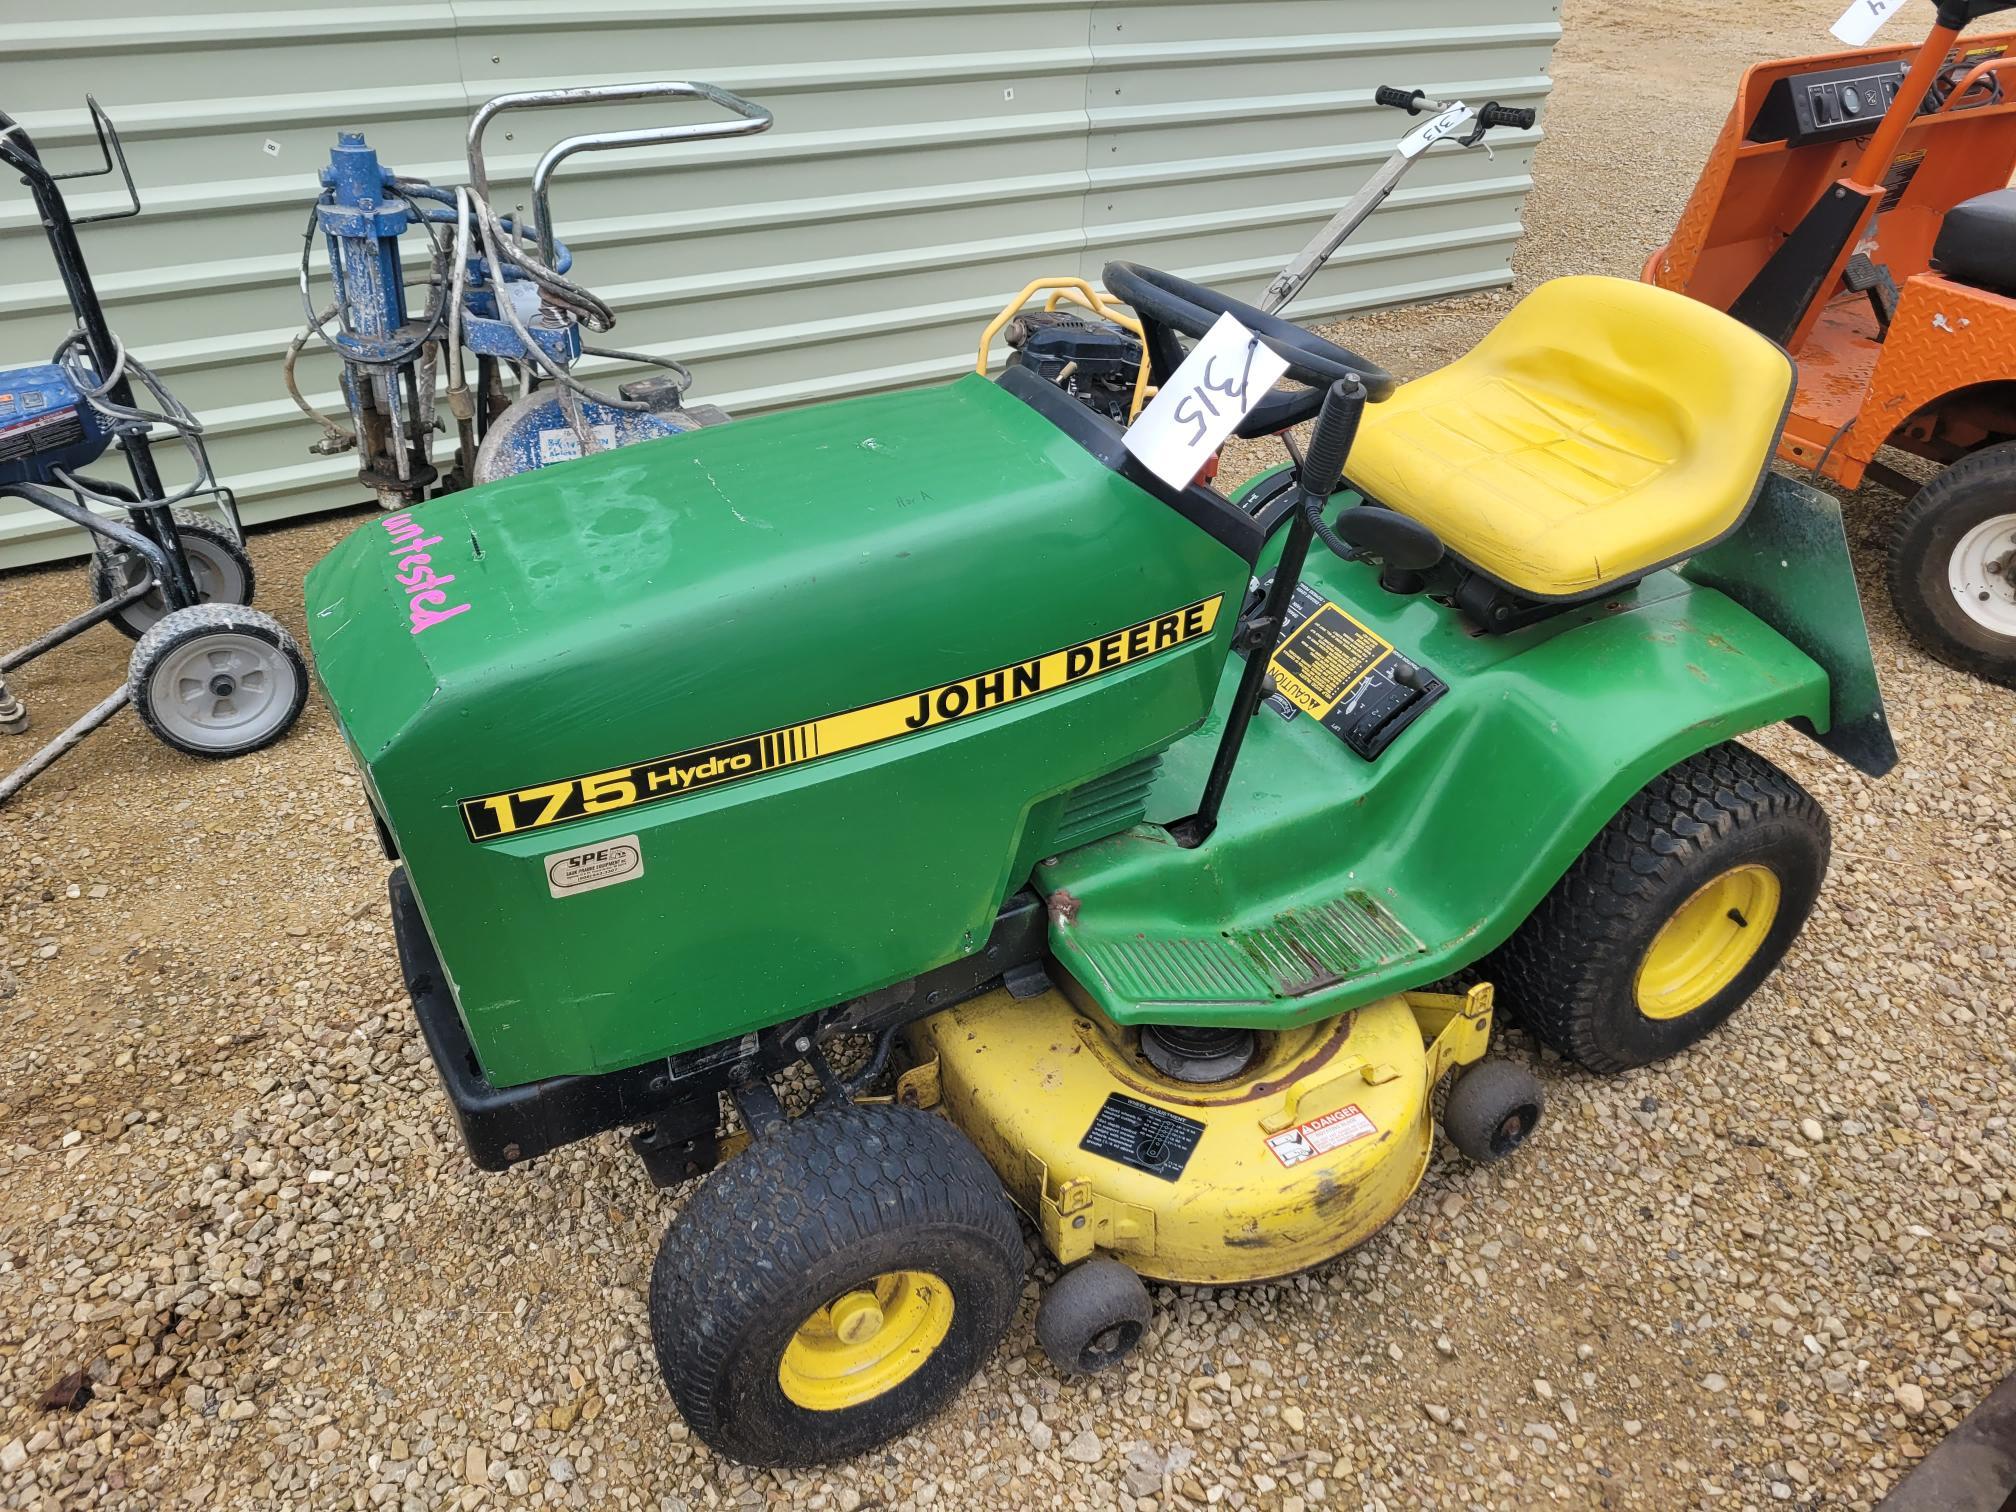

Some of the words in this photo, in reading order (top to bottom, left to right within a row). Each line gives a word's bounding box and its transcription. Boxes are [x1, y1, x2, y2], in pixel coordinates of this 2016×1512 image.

[1423, 115, 1454, 141] 313
[1174, 355, 1246, 447] 315
[381, 513, 472, 635] untested
[905, 660, 1042, 729] JOHN
[1066, 604, 1205, 681] DEERE
[1268, 665, 1308, 703] CAUTION
[1331, 723, 1340, 731] LIFT
[484, 769, 637, 833] 175
[648, 752, 752, 791] Hydro
[566, 849, 608, 868] SPE
[1311, 1105, 1360, 1130] DANGER
